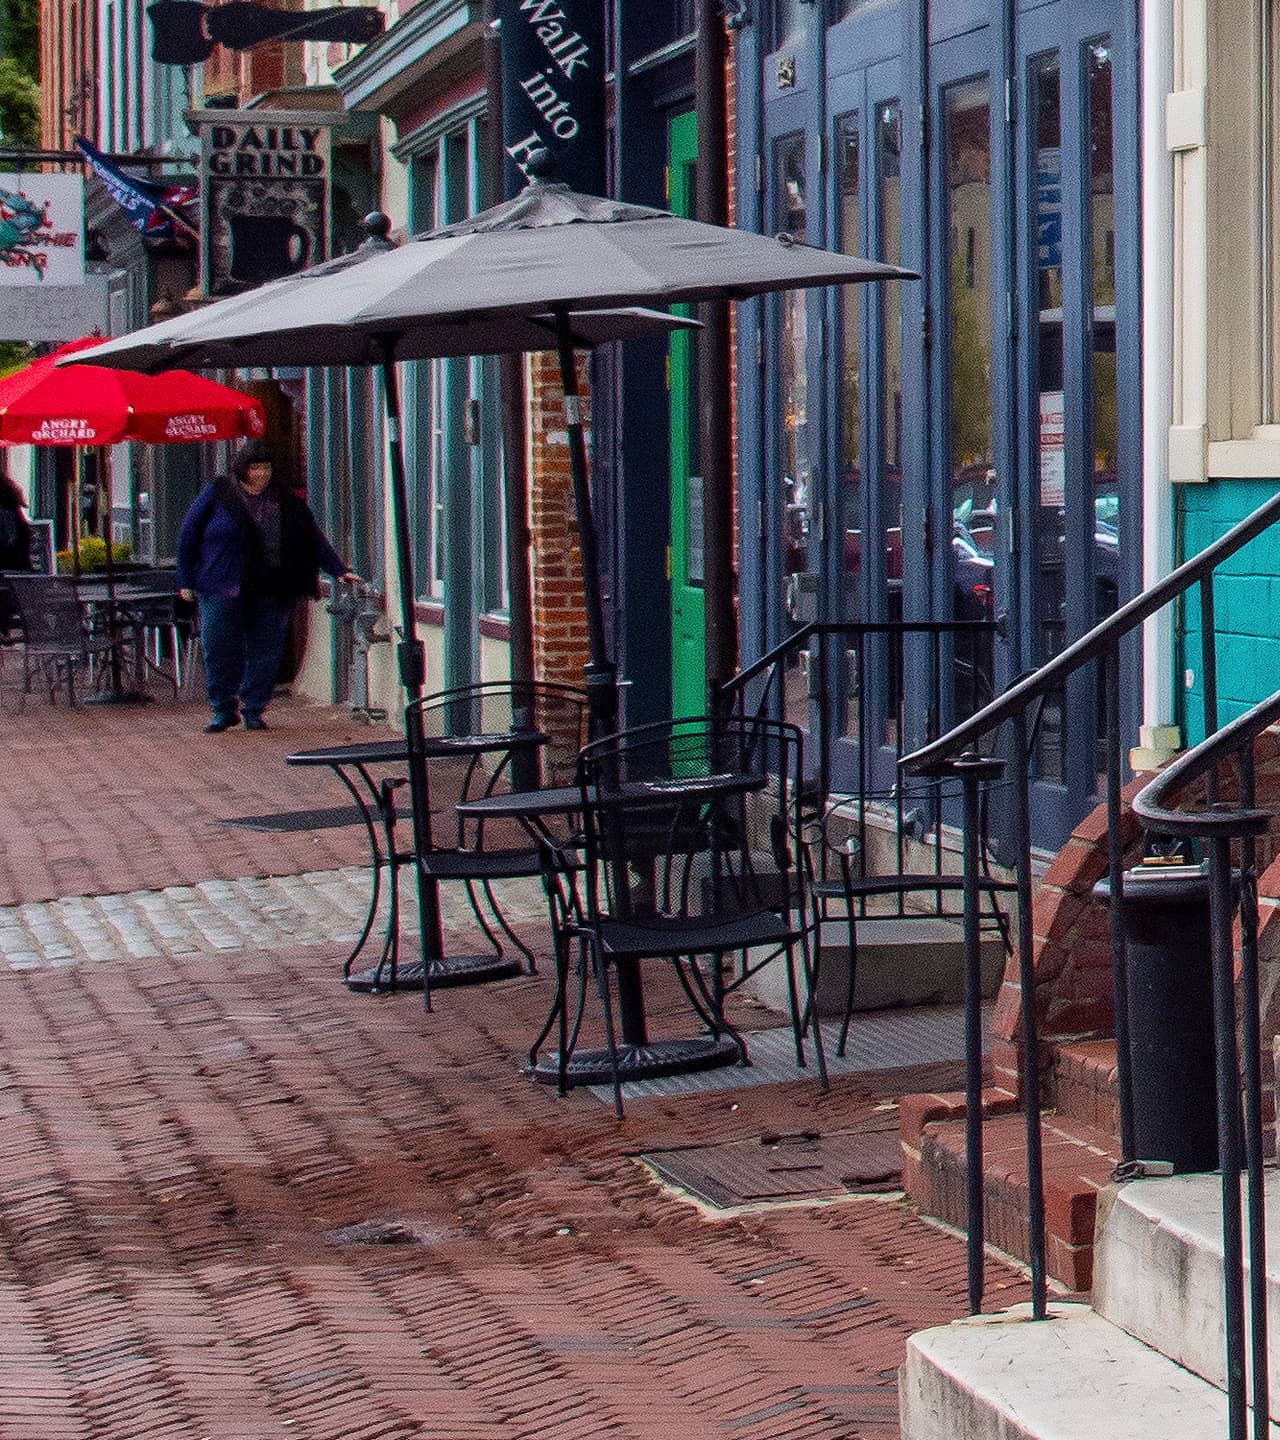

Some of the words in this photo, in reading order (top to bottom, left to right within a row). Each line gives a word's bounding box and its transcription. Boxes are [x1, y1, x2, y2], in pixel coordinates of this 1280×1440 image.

[519, 67, 579, 140] into
[212, 126, 323, 151] DAILY
[209, 152, 325, 175] GRIND
